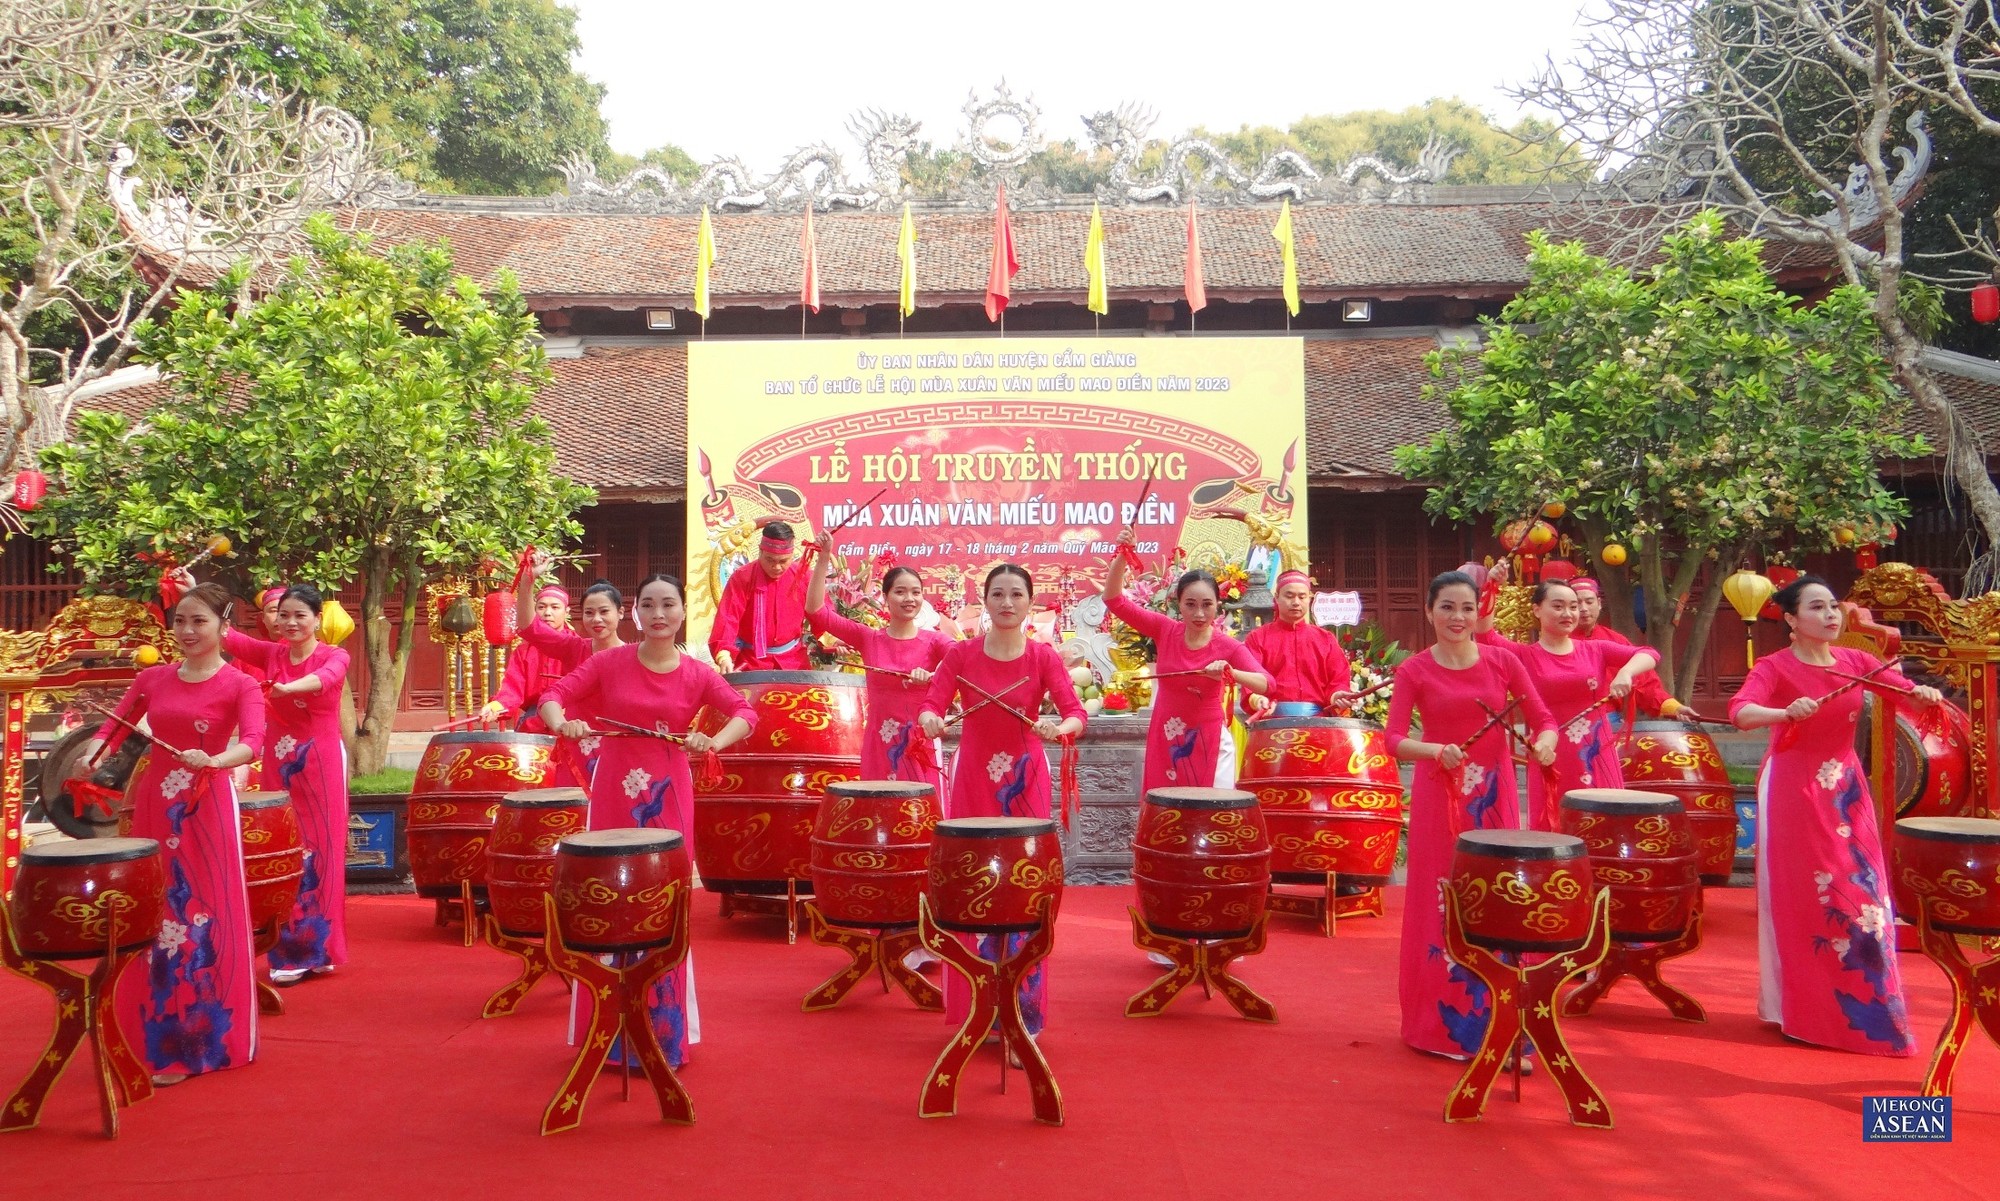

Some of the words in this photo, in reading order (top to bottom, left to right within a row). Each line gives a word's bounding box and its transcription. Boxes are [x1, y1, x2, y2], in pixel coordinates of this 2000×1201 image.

[857, 351, 877, 370] ỦY
[882, 355, 911, 369] BAN
[917, 351, 957, 369] NHÂN
[963, 351, 993, 368] DÂN
[998, 353, 1048, 369] HUYỆN
[1053, 348, 1085, 367] CẨM
[1090, 351, 1136, 367] GIÀNG
[765, 380, 794, 394] BAN
[799, 375, 818, 394] TỔ
[823, 377, 862, 394] CHỨC
[866, 374, 885, 393] LỄ
[890, 376, 915, 395] HỘI
[920, 376, 953, 392] MÙA
[957, 376, 998, 392] XUÂN
[1002, 375, 1032, 391] VĂN
[1037, 373, 1074, 391] MIẾU
[1079, 377, 1112, 391] MAO
[1116, 373, 1152, 391] ĐIỀN
[1157, 375, 1191, 391] NĂM
[1196, 377, 1230, 391] 2023
[809, 439, 850, 483] LỄ
[862, 446, 922, 489] HỘI
[931, 436, 1063, 483] TRUYỀN
[1073, 438, 1187, 482] THỐNG
[822, 499, 873, 527] MÙA
[879, 498, 940, 528] XUÂN
[947, 498, 992, 526] VĂN
[1000, 494, 1056, 526] MIẾU
[1064, 501, 1114, 525] MAO
[1121, 493, 1175, 525] ĐIỀN
[838, 541, 864, 556] Cẩm
[905, 543, 933, 557] ngày
[938, 543, 952, 555] 17
[966, 543, 979, 555] 18
[984, 542, 1016, 556] tháng
[1021, 543, 1029, 554] 2
[1033, 542, 1058, 554] năm
[1063, 541, 1085, 556] Quý
[1090, 541, 1116, 554] Mão
